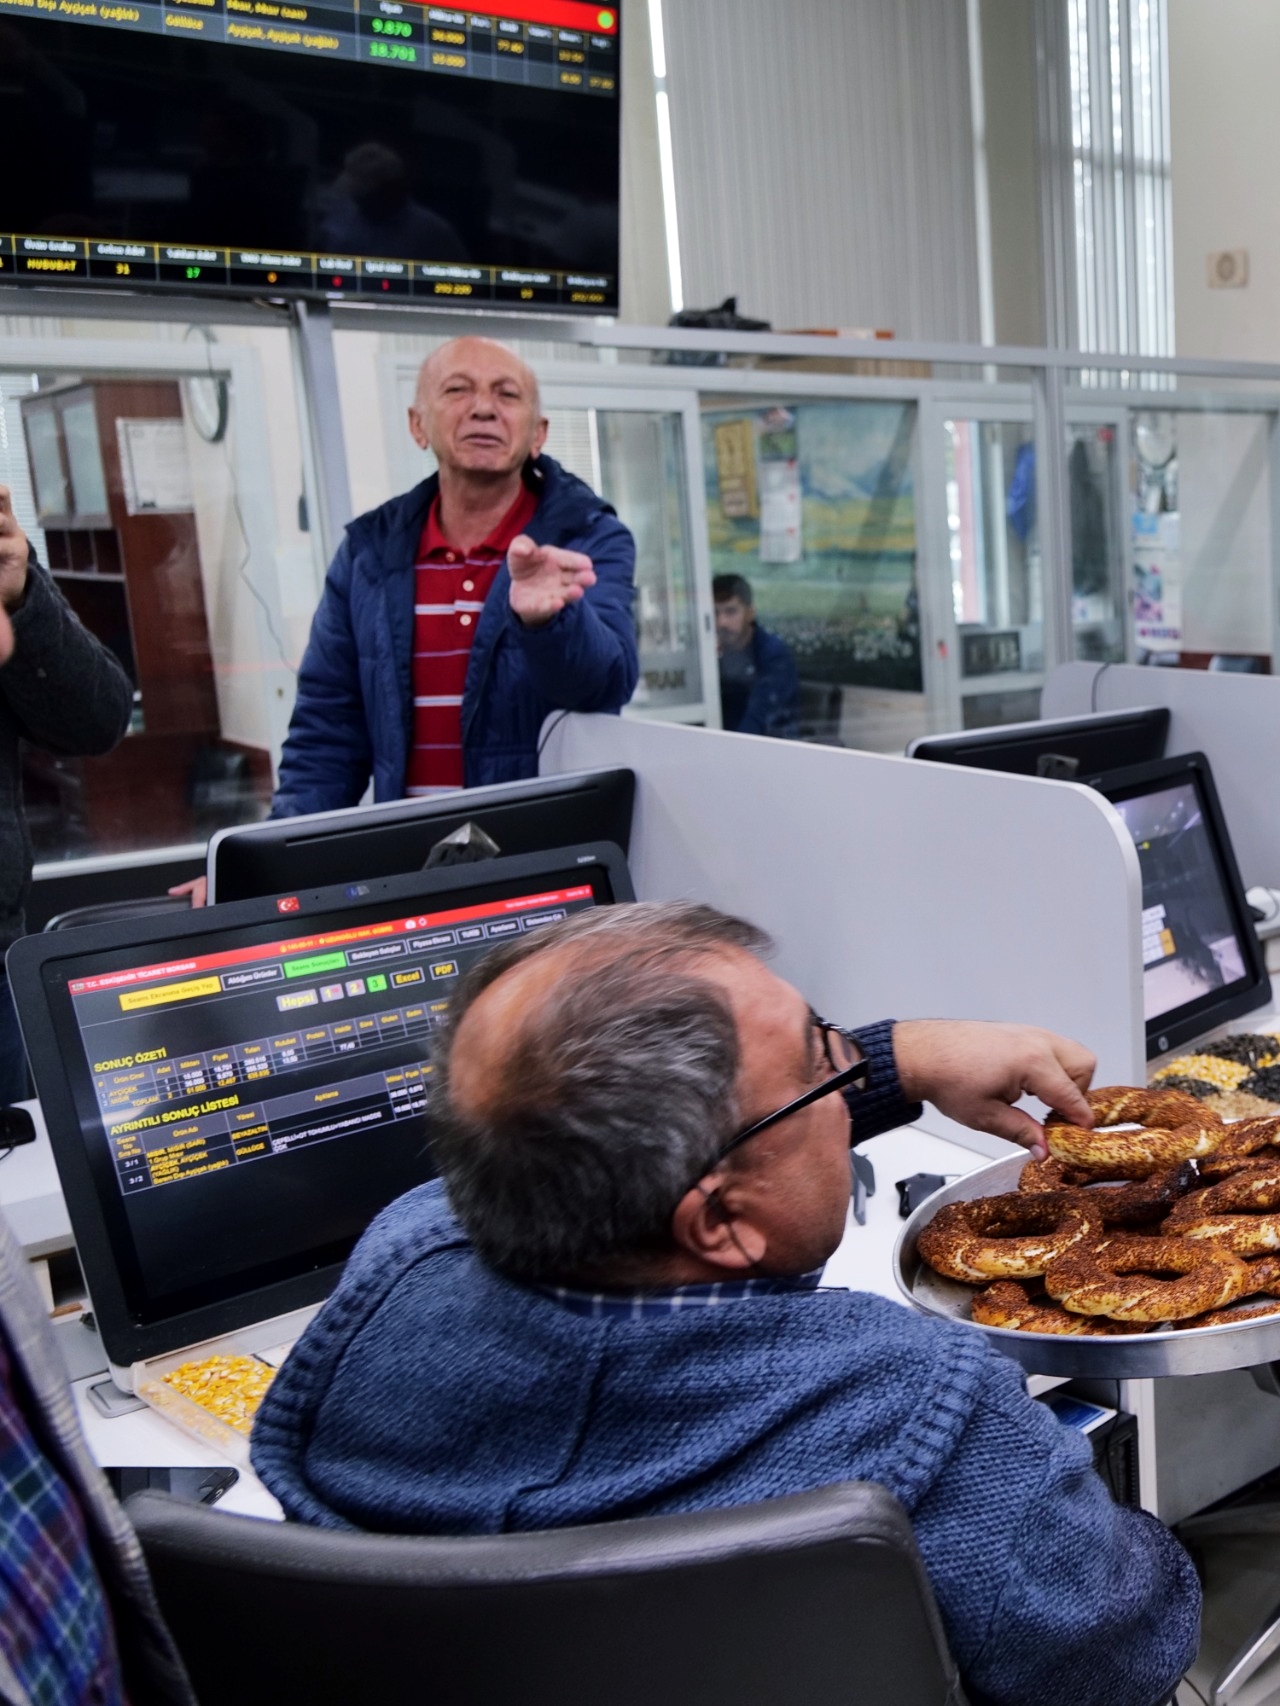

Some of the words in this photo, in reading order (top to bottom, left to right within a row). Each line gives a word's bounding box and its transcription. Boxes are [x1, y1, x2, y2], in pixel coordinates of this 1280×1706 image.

[396, 970, 420, 985] Excel
[435, 963, 453, 976] PDF
[281, 989, 315, 1008] Hepsi
[94, 1054, 134, 1073] SONUÇ
[134, 1047, 168, 1064] ÖZETİ
[110, 1116, 161, 1135] AYRINTILI
[161, 1106, 200, 1123] SONUÇ
[200, 1094, 239, 1113] LİSTESİ
